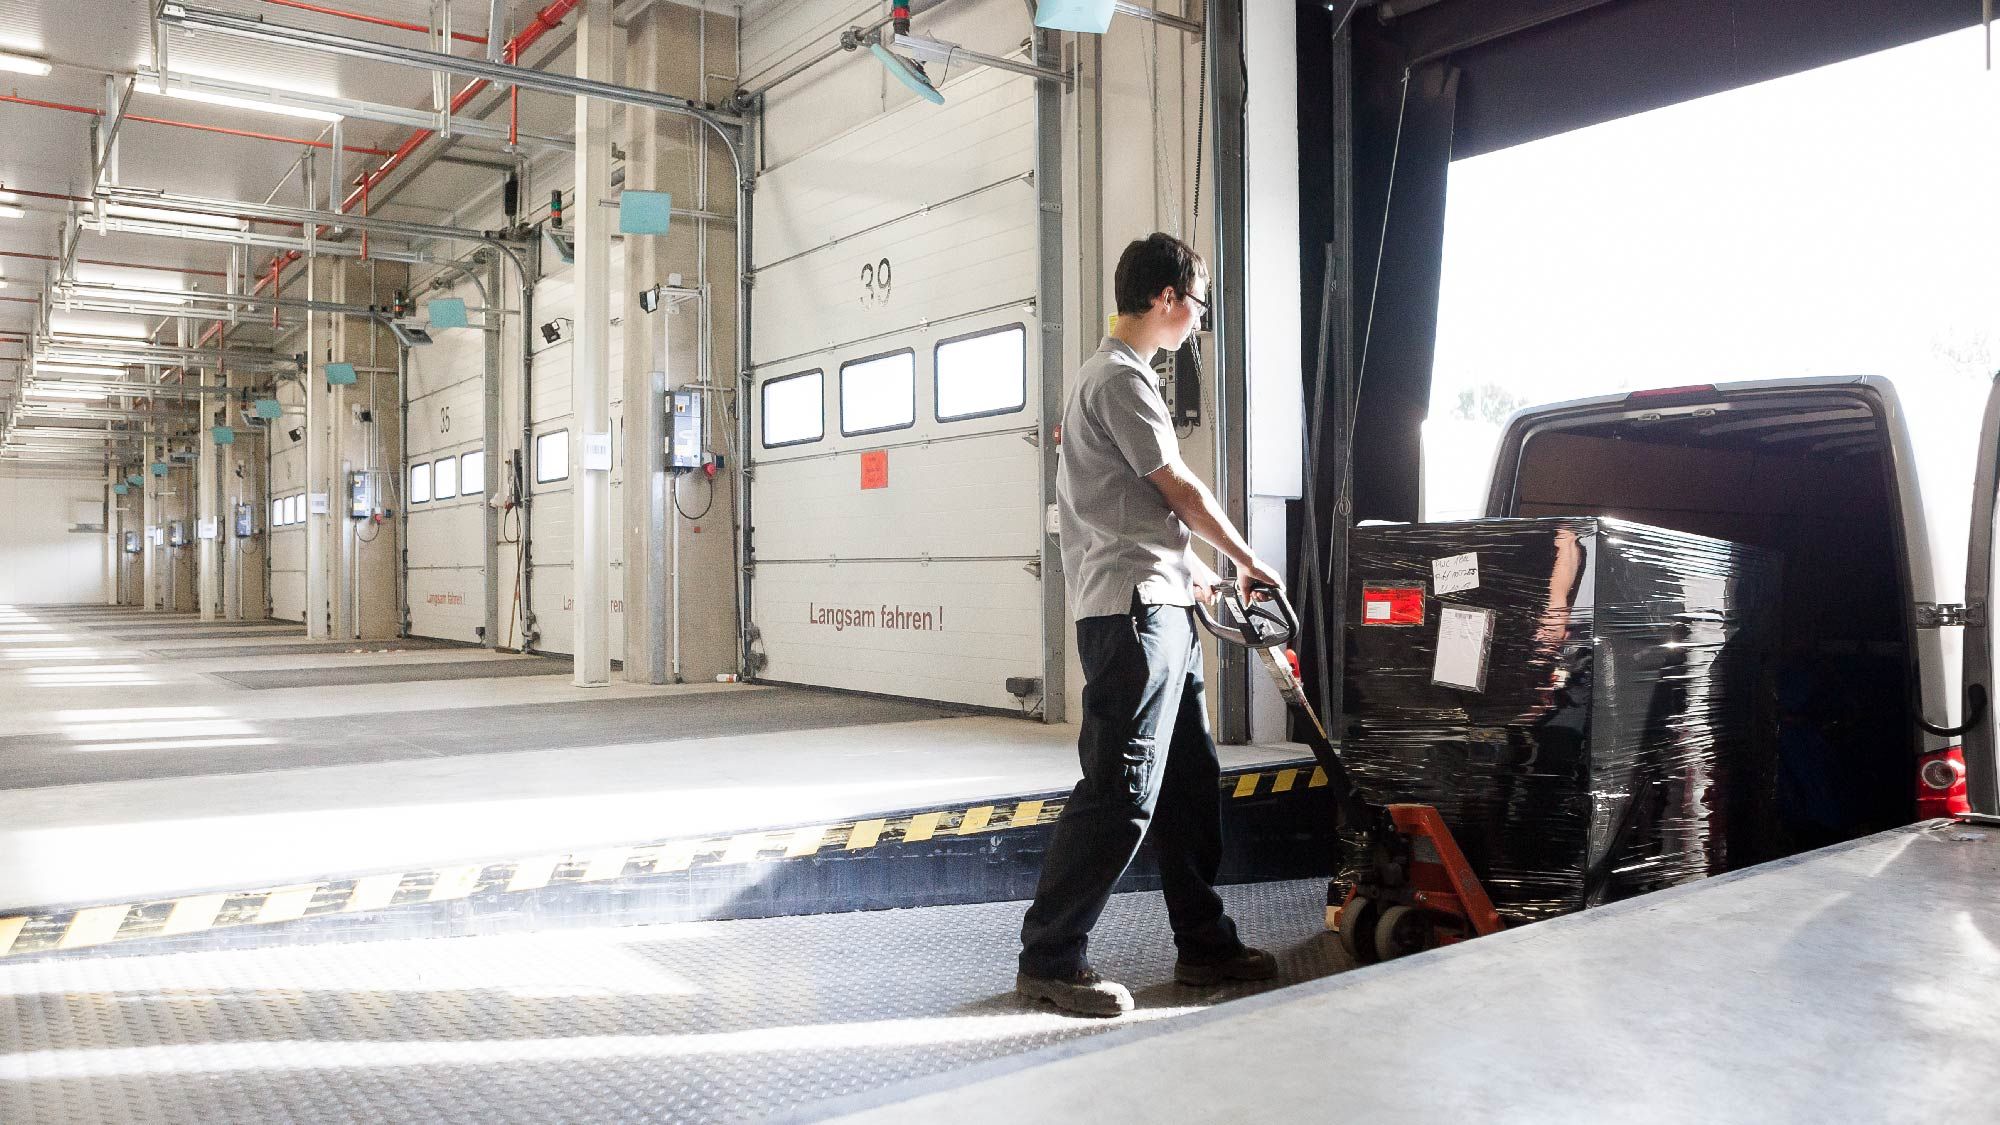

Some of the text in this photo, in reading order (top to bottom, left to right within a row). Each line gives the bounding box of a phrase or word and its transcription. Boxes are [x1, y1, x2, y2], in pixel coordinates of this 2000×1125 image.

[860, 257, 892, 308] 39
[810, 602, 876, 632] Langsam
[880, 604, 933, 631] fahren
